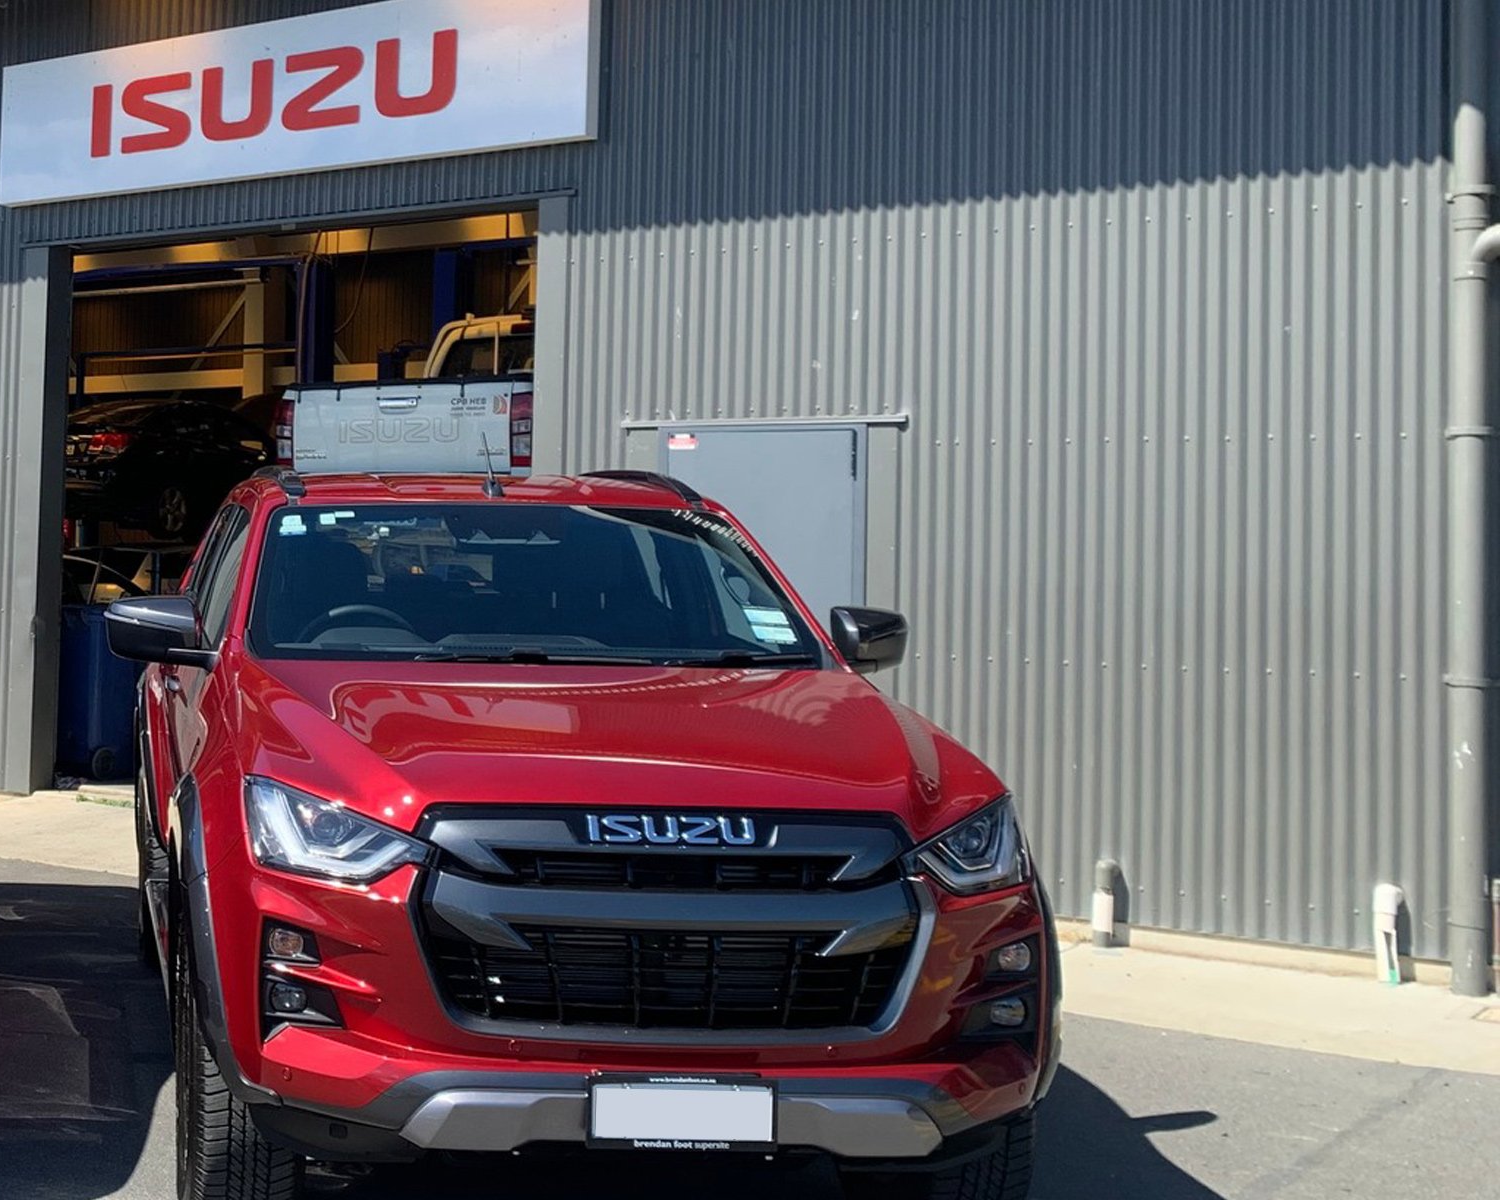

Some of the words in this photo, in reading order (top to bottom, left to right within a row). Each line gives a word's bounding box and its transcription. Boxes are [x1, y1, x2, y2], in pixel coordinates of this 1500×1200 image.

[90, 28, 458, 159] ISUZU
[338, 416, 462, 444] ISUZU
[586, 815, 755, 844] ISUZU
[634, 1140, 672, 1149] brendan
[673, 1140, 693, 1149] foot
[694, 1141, 730, 1151] supersite
